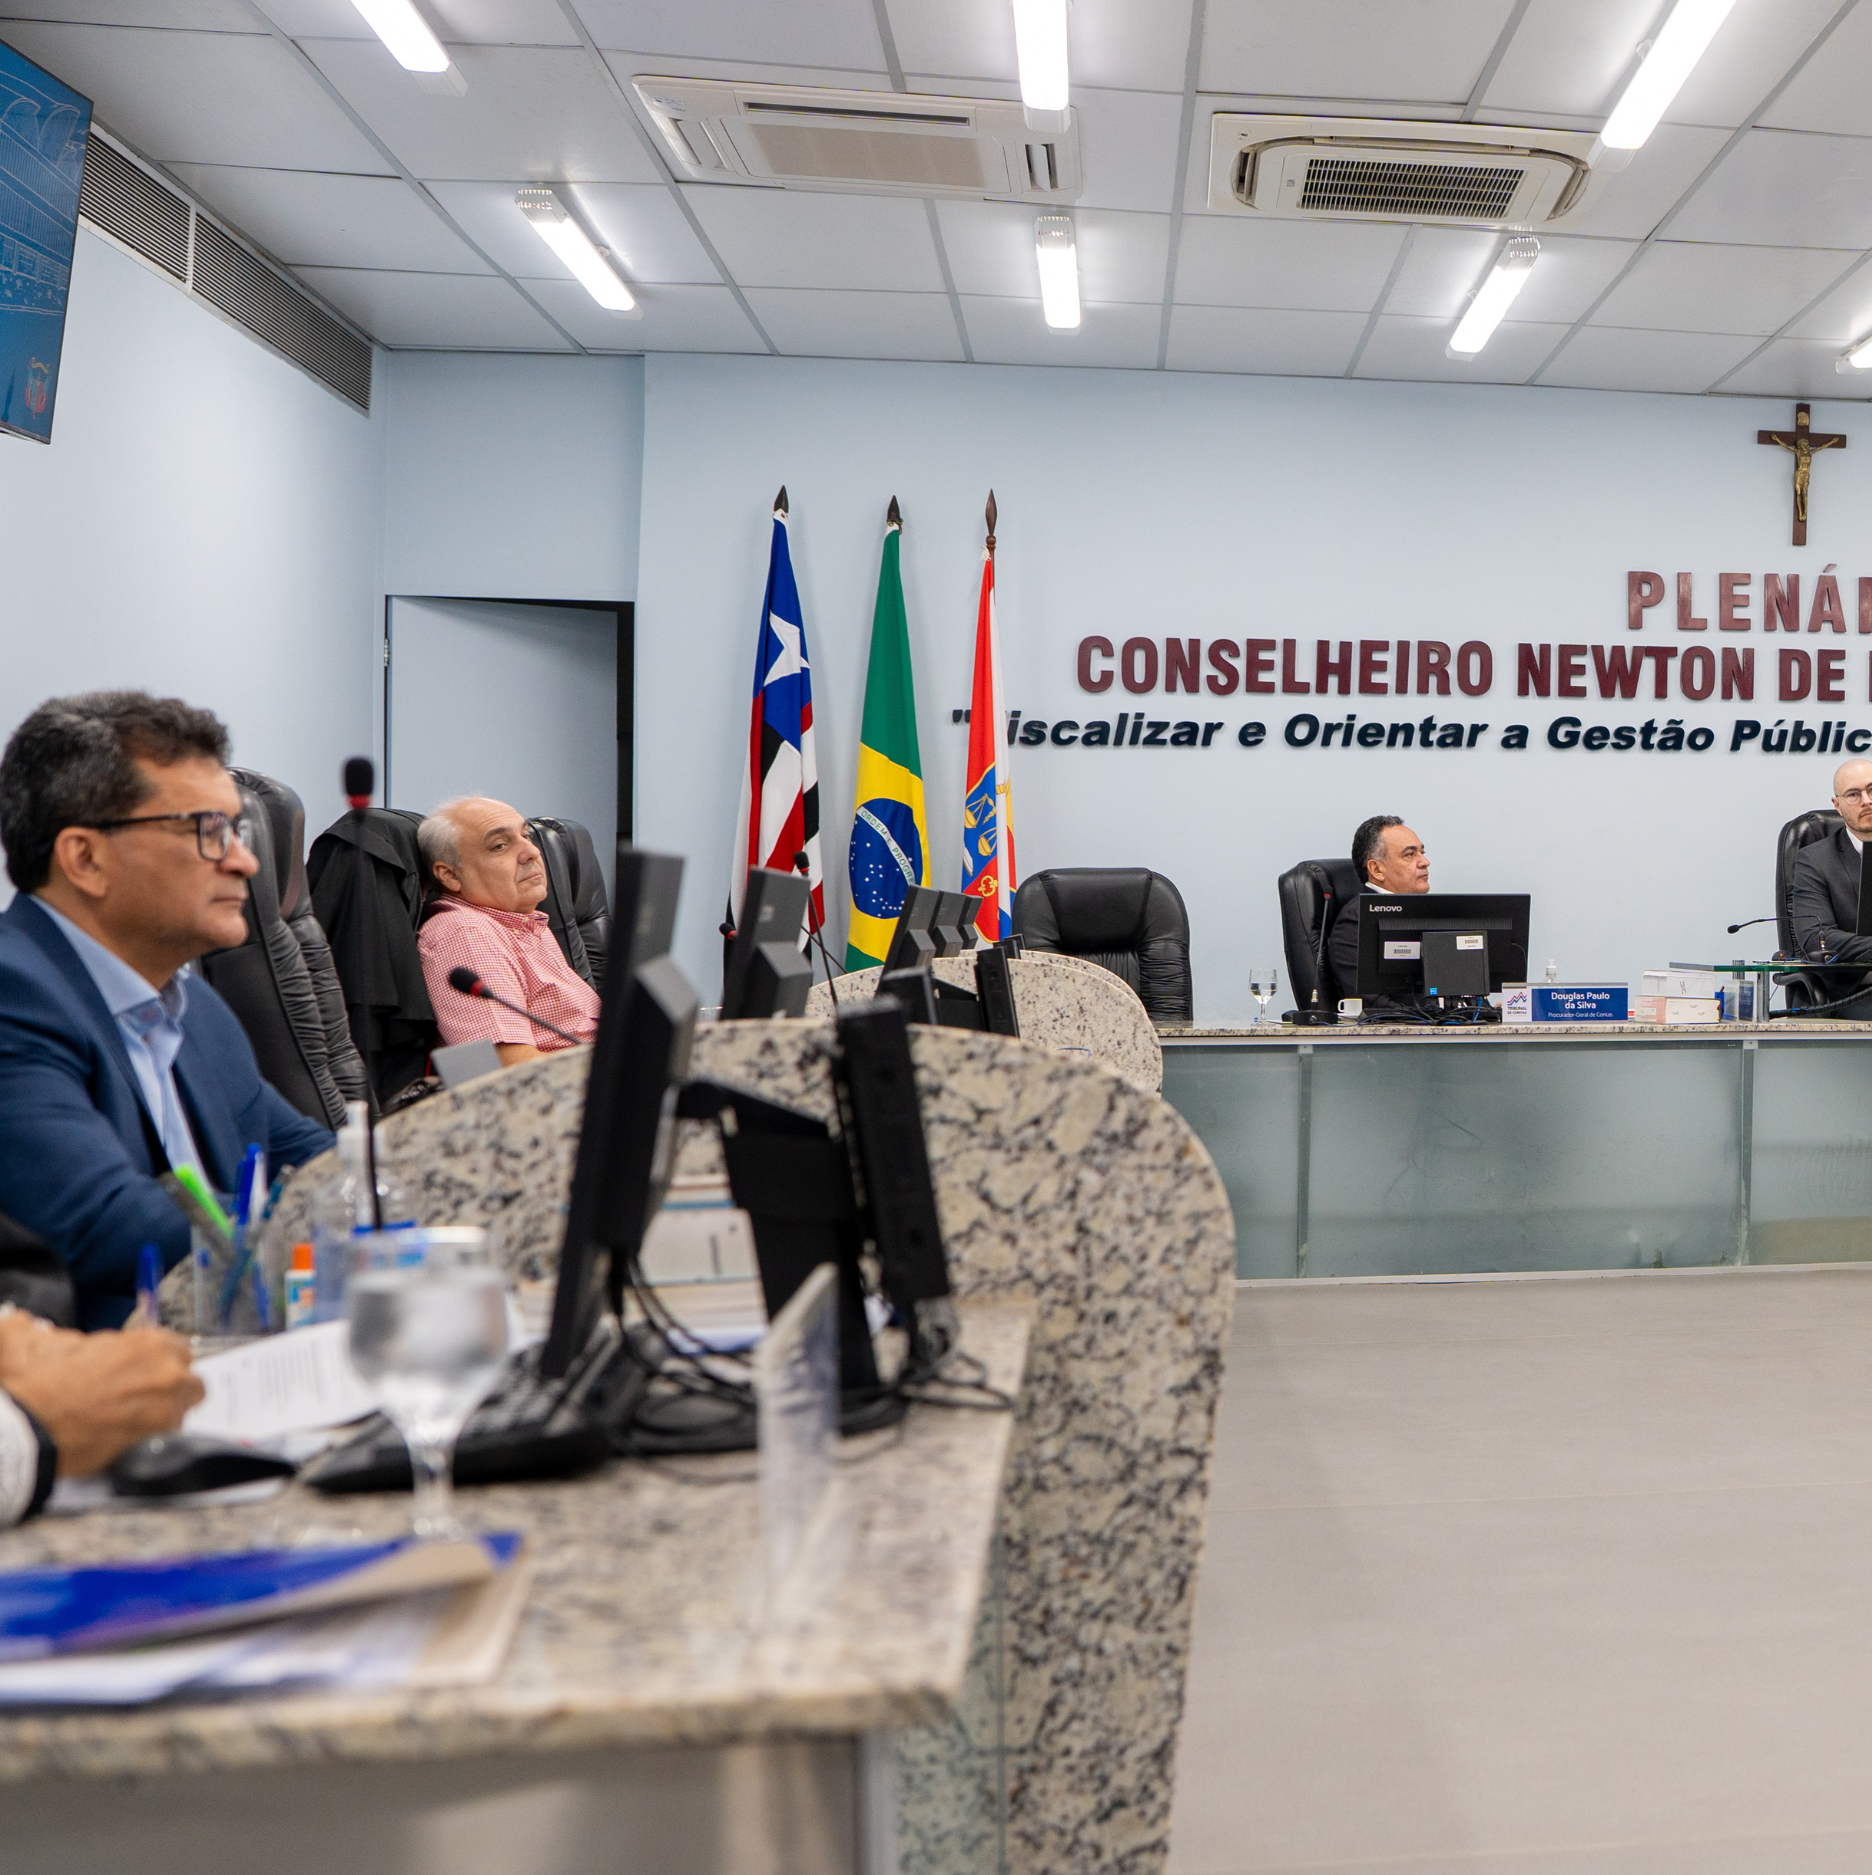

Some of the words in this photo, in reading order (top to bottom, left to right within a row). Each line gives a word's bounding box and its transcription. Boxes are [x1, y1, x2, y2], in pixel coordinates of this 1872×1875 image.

[1077, 635, 1493, 696] CONSELHEIRO
[1517, 642, 1755, 701] NEWTON
[1778, 648, 1846, 703] DE
[952, 709, 1224, 747] "iscalizar
[1238, 721, 1266, 747] e
[1284, 712, 1488, 748] Orientar
[1500, 723, 1529, 749] a
[1547, 716, 1715, 751] Gestão
[861, 810, 888, 836] ORDEM
[892, 847, 914, 884] PROGRE
[1369, 904, 1402, 912] Lenovo
[1551, 992, 1585, 1001] Douglas
[1586, 992, 1610, 1000] Paulo
